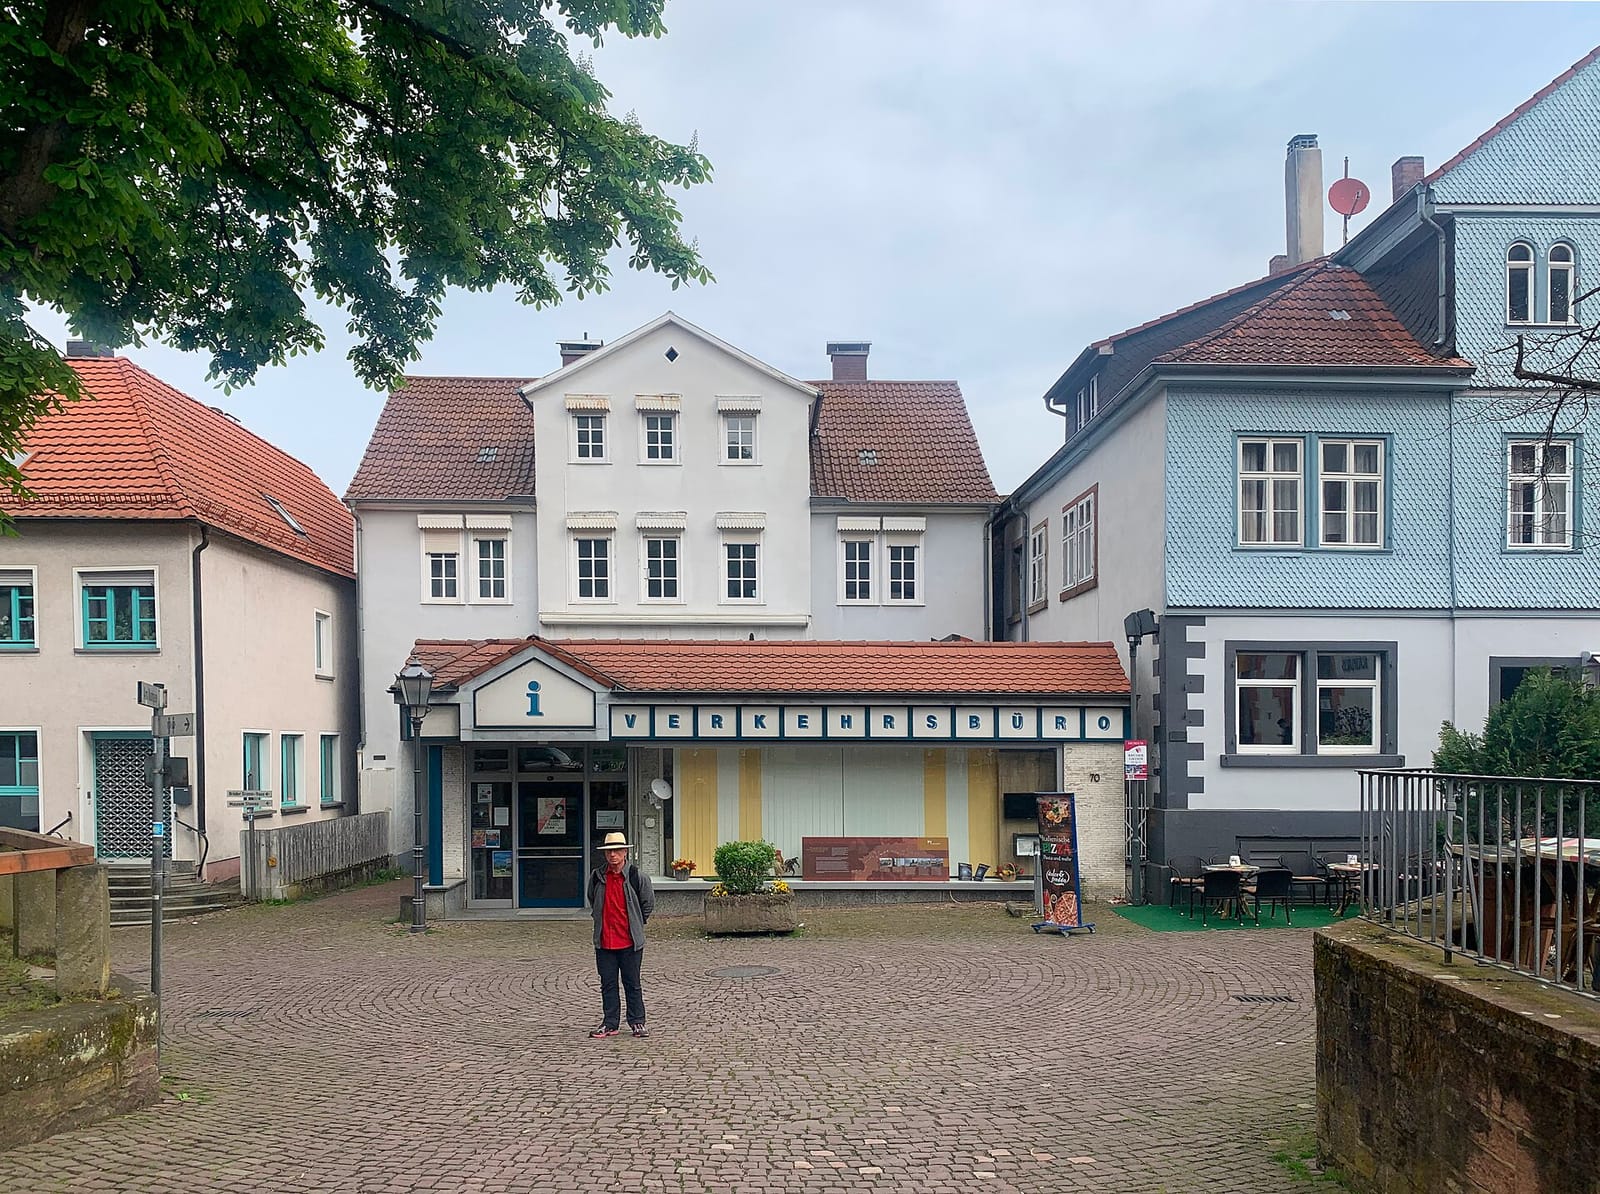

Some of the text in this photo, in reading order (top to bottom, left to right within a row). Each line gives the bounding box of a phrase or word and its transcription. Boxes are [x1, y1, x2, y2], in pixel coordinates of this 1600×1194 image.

[526, 680, 545, 716] i
[624, 712, 1111, 731] VERKEHRSBÜRO
[1089, 773, 1100, 783] 70
[1042, 843, 1071, 855] PIZZA
